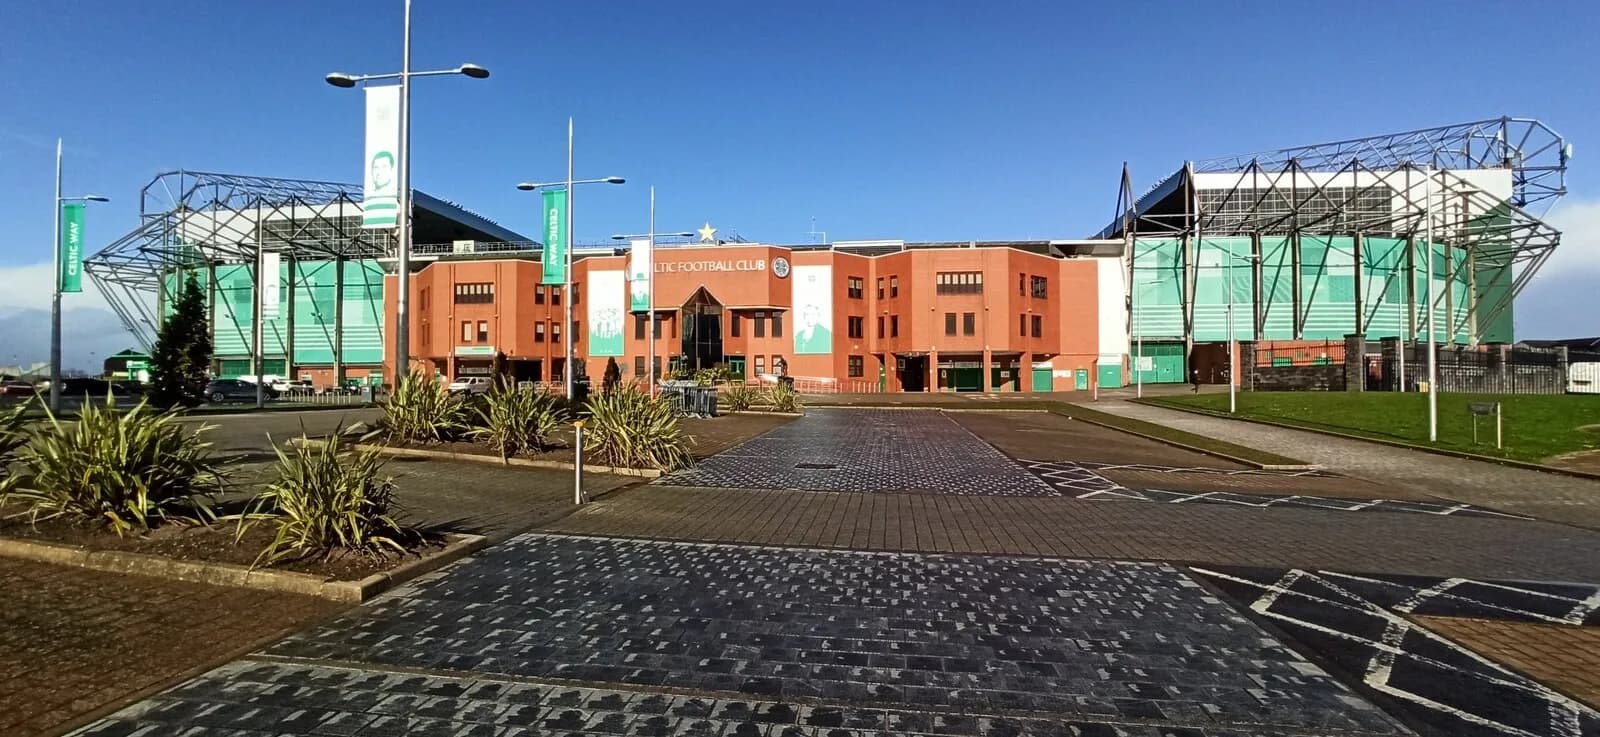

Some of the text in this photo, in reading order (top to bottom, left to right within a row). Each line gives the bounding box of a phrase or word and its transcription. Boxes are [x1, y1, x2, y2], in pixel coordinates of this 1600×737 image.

[68, 222, 79, 275] CELTIC WAY
[549, 208, 559, 267] CELTIC WAY
[654, 259, 766, 273] LTIC FOOTBALL CLUB
